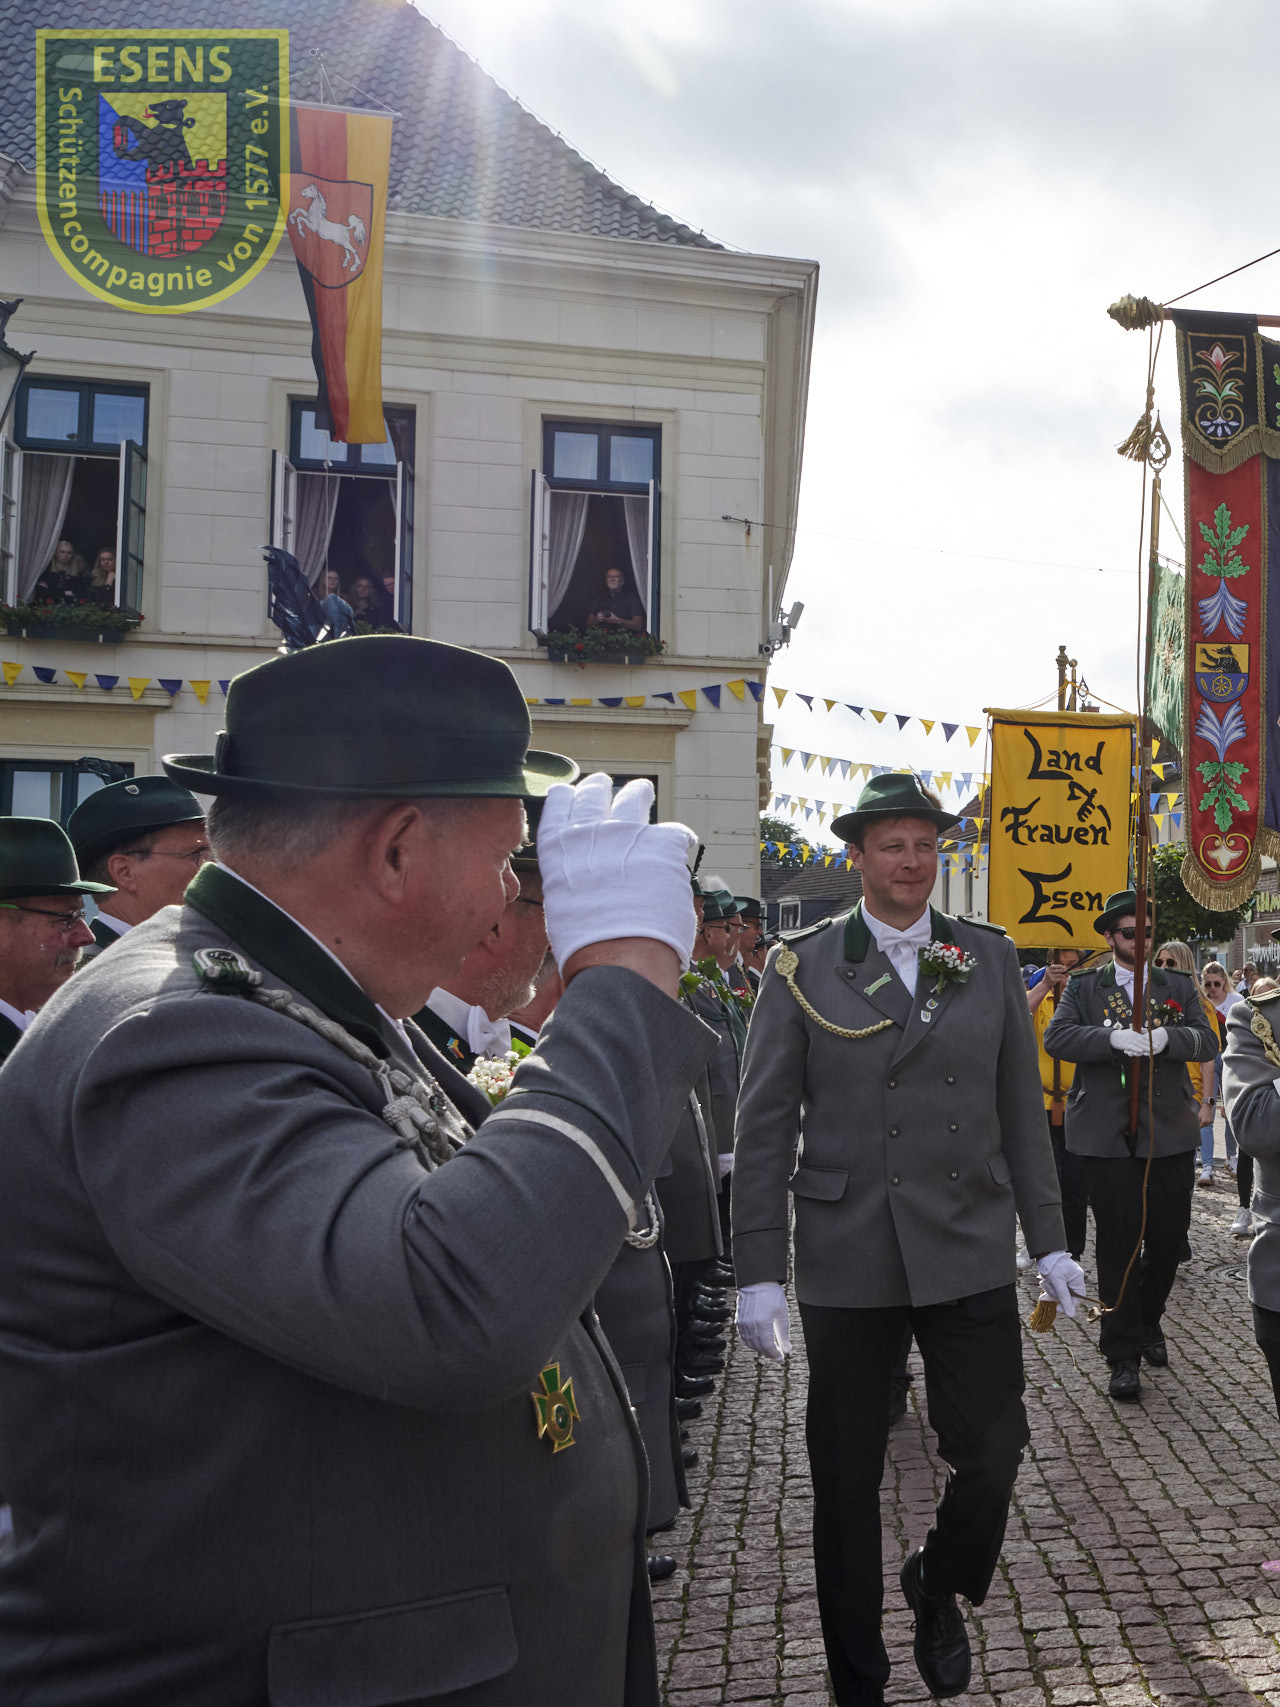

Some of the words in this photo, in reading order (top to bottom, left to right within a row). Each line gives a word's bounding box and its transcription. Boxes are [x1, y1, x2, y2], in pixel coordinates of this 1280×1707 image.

[1024, 728, 1105, 779] Land
[1000, 797, 1110, 845] Frauen
[1018, 862, 1104, 937] Esen
